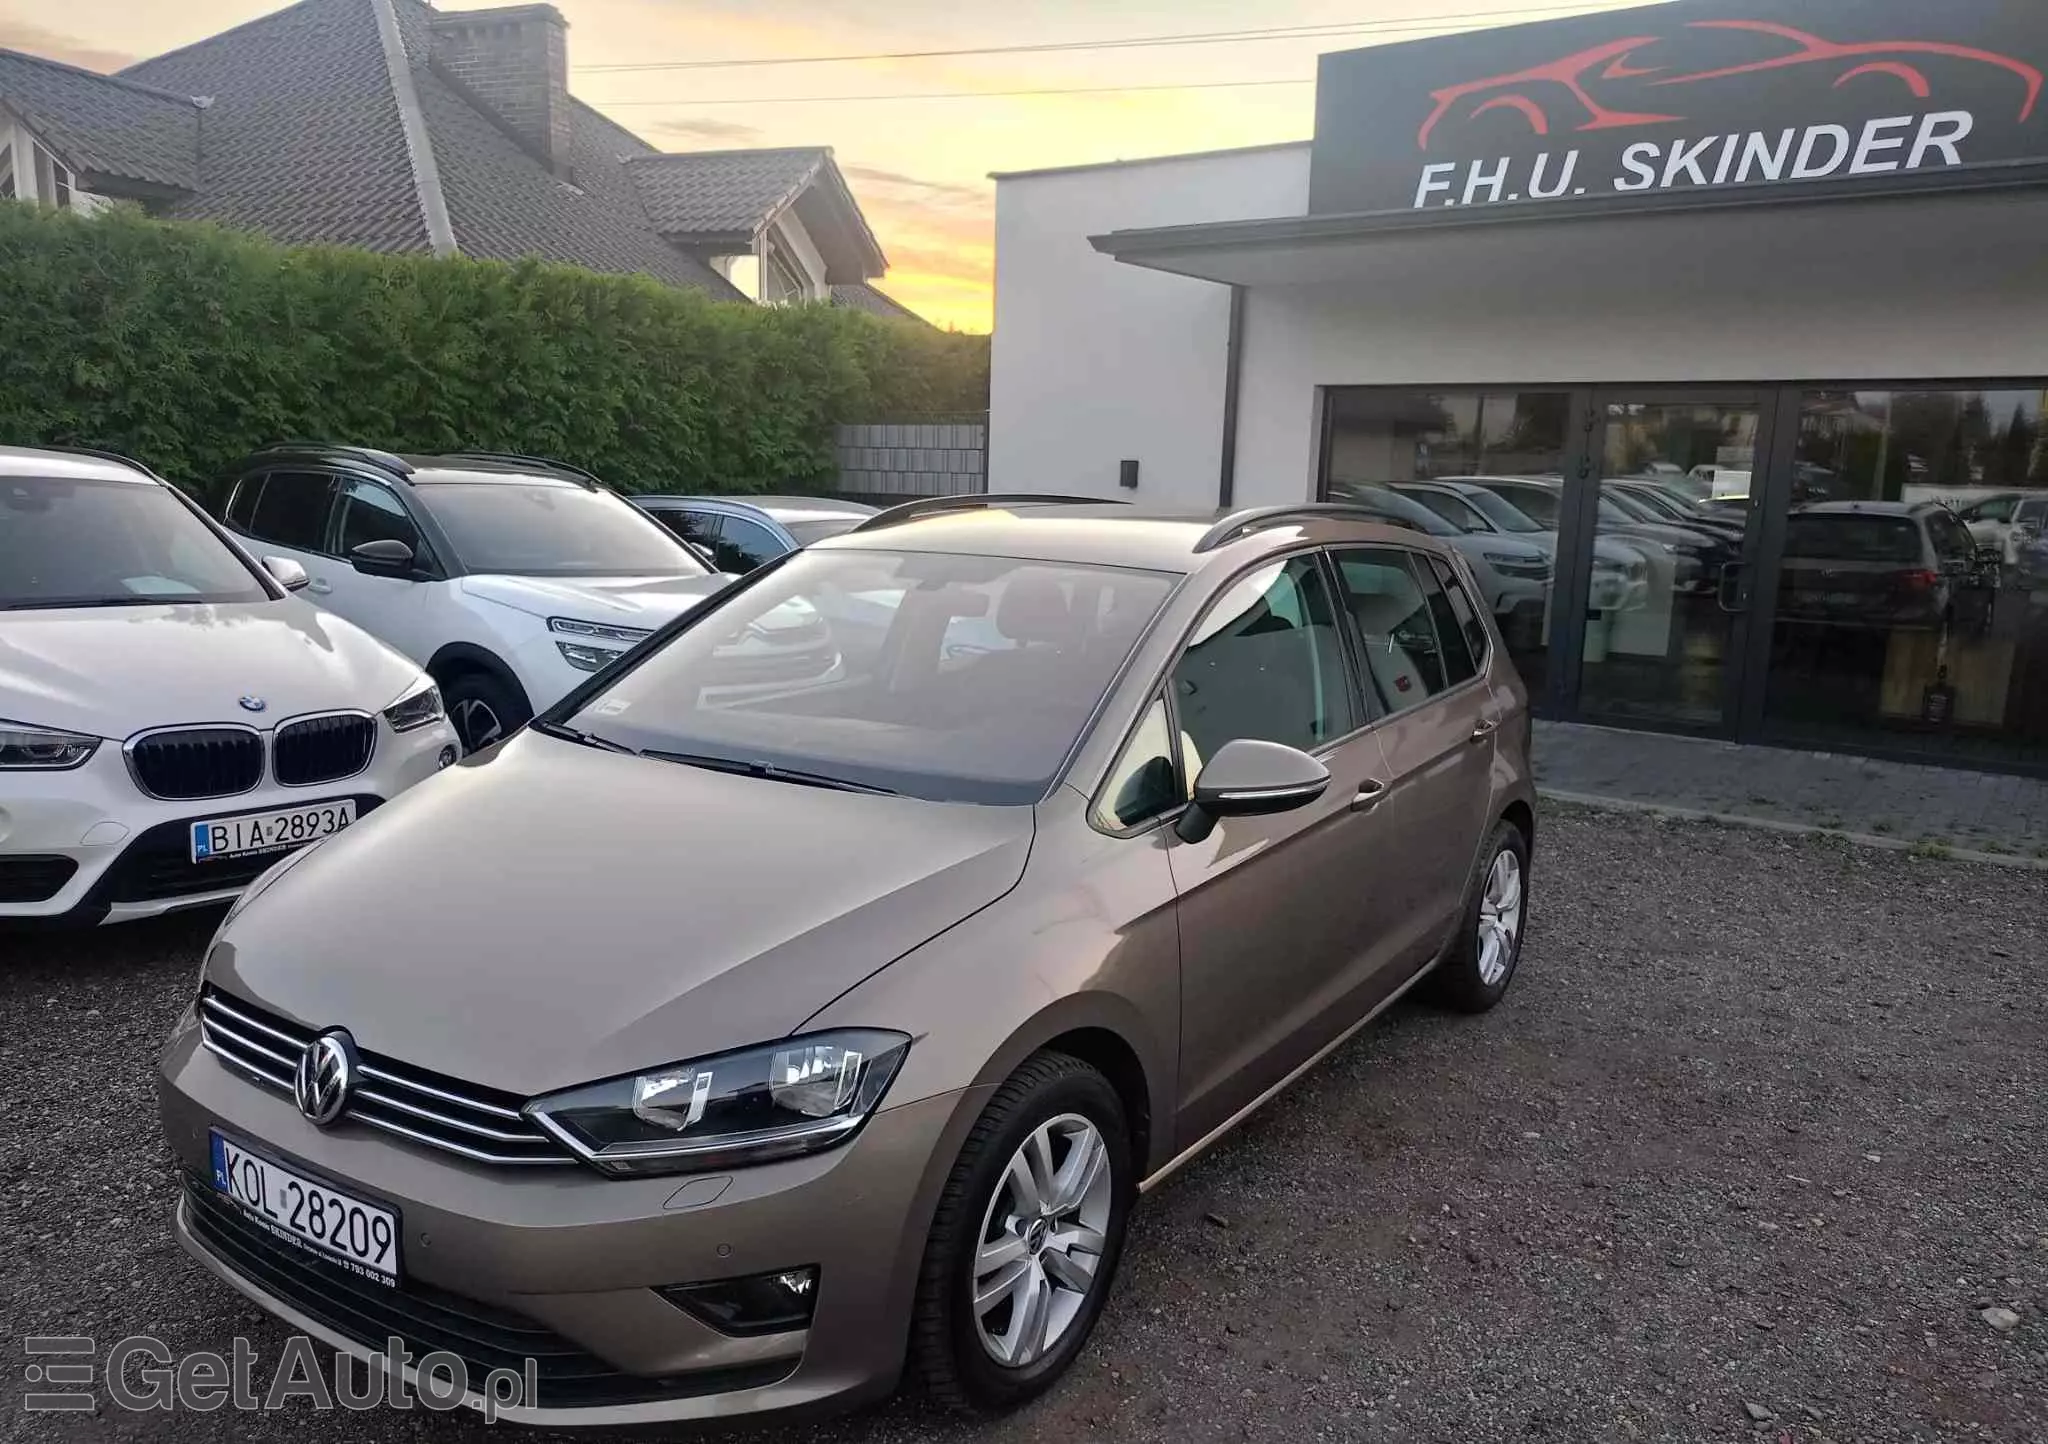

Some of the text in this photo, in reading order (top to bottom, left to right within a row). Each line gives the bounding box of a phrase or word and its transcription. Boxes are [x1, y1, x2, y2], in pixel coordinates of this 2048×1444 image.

[1414, 110, 1974, 209] F.H.U. SKINDER
[211, 806, 350, 851] BIA 2893A
[216, 1168, 227, 1186] PL
[226, 1147, 392, 1264] KOL 28209
